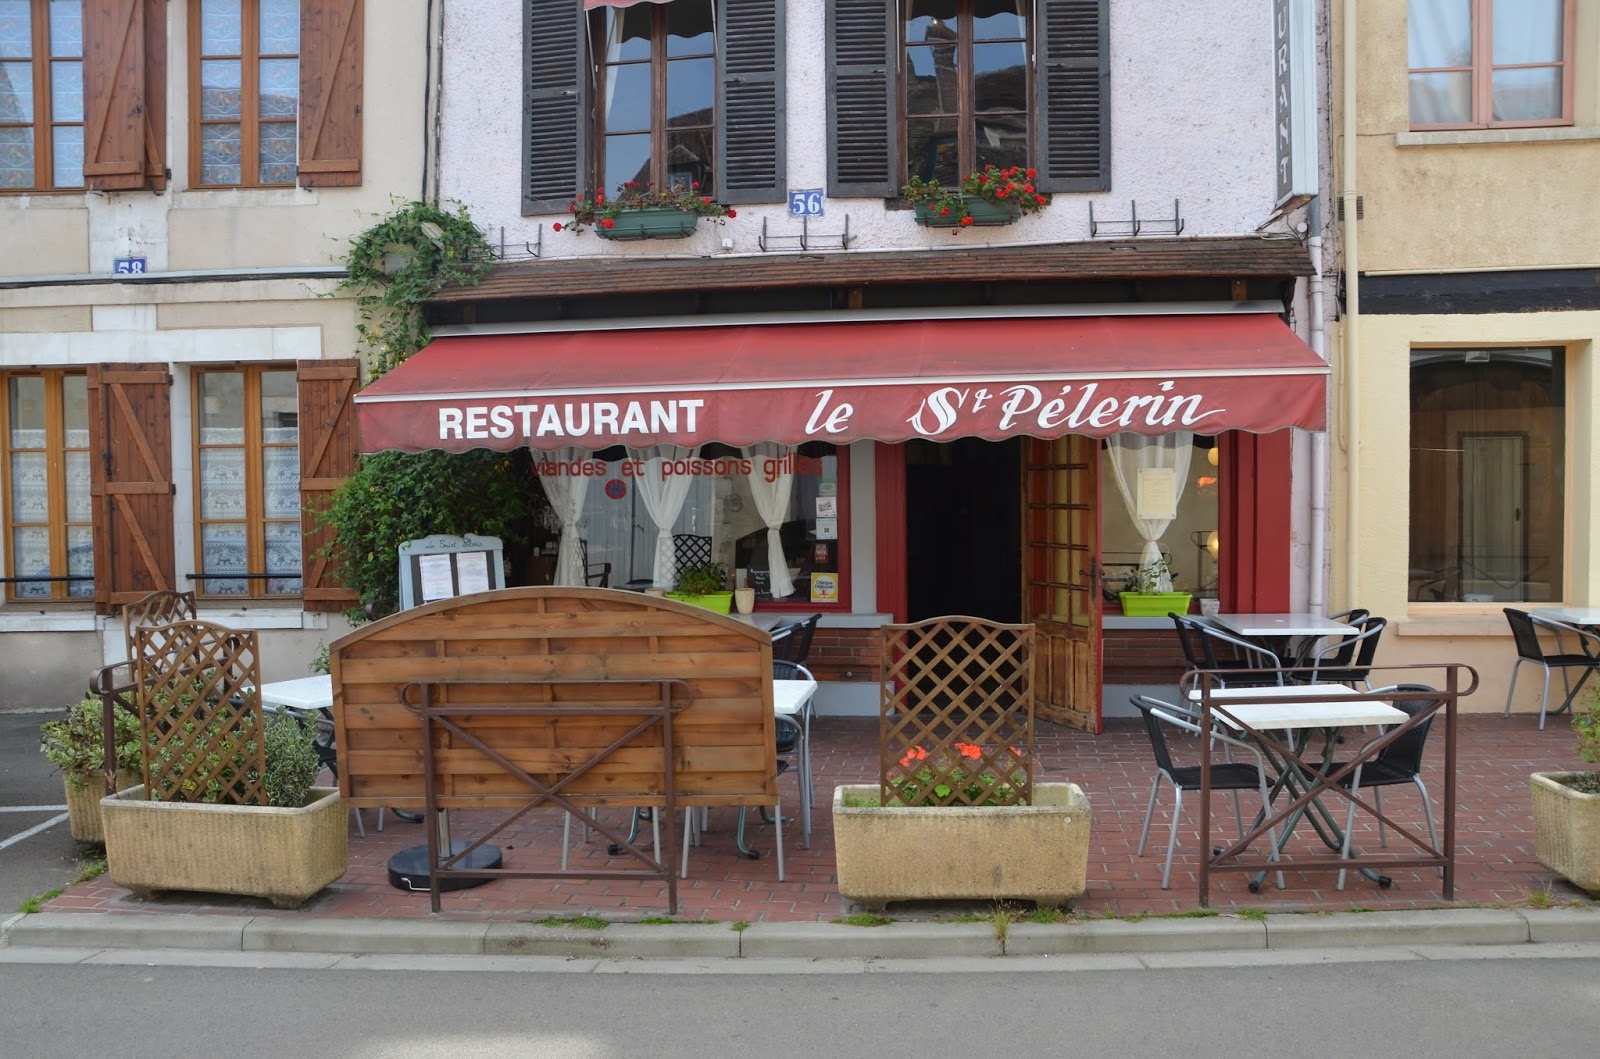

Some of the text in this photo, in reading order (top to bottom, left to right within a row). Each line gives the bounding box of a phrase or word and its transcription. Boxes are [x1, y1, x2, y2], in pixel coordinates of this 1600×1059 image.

[1277, 0, 1289, 184] URANT
[792, 192, 821, 214] 56
[117, 261, 143, 274] 58
[439, 399, 704, 440] RESTAURANT
[804, 380, 1226, 436] le St Pélerin
[529, 457, 607, 477] viandes
[621, 457, 646, 477] et
[661, 456, 752, 482] poissons
